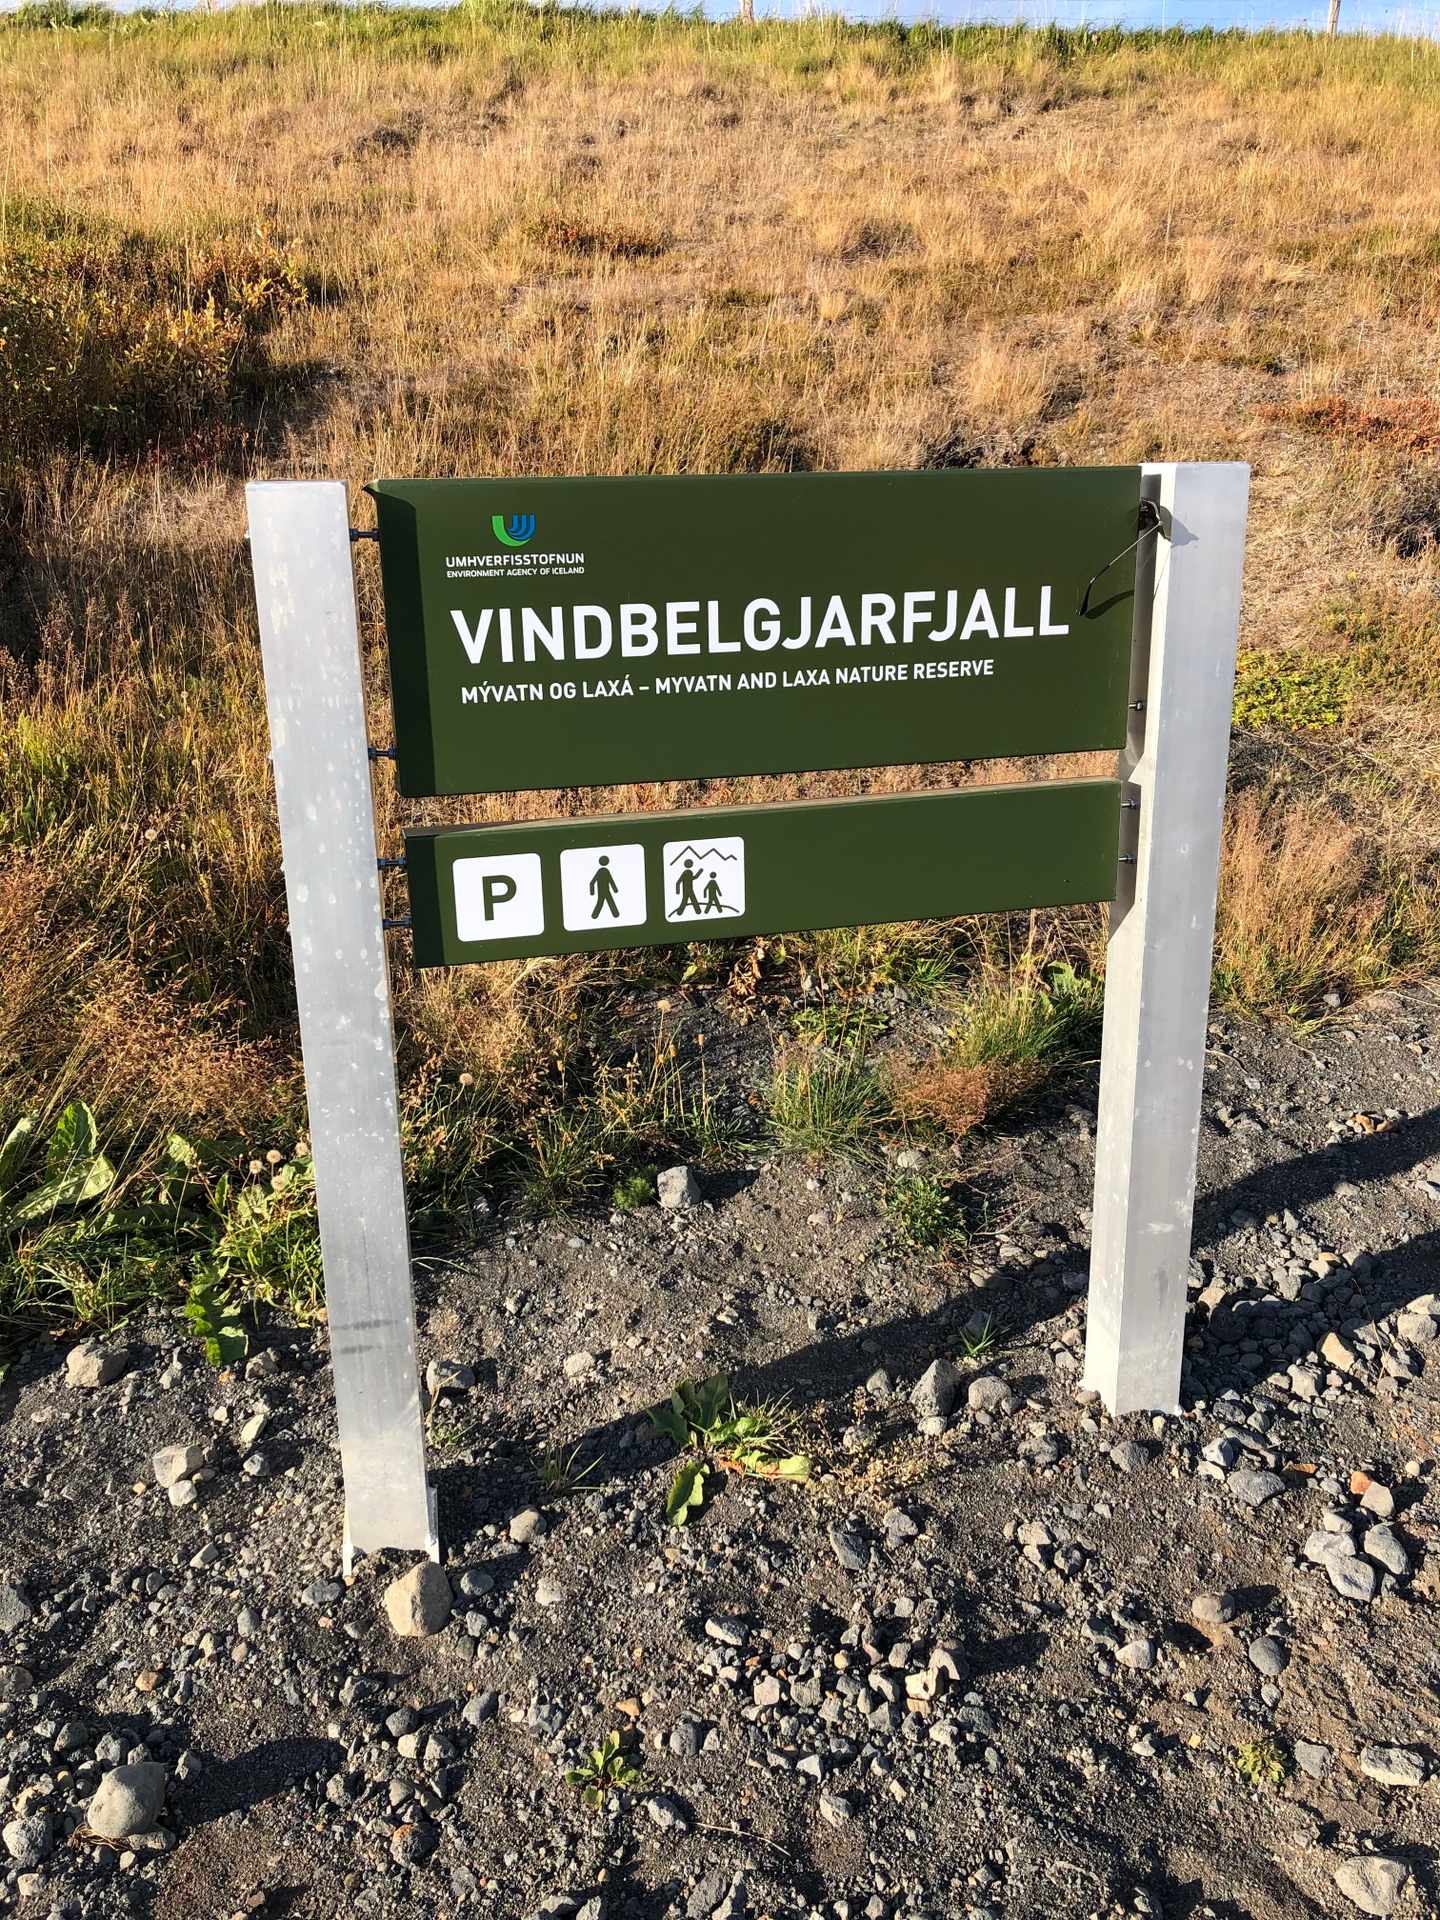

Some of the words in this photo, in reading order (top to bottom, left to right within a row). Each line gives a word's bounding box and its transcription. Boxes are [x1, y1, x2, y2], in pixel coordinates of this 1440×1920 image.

[445, 552, 585, 568] UMHVERFISSTOFNUN
[446, 568, 505, 579] ENVIRONMENT
[506, 567, 538, 577] AGENCY
[539, 567, 551, 576] OF
[551, 566, 585, 576] ICELAND
[449, 585, 1070, 665] VINDBELGJARFJALL
[461, 680, 544, 705] MÝVATN
[549, 681, 577, 700] OG
[582, 673, 634, 698] LAXÁ
[655, 673, 732, 695] MYVATN
[736, 671, 777, 691] AND
[782, 668, 831, 688] LAXA
[835, 663, 909, 685] NATURE
[913, 658, 995, 680] RESERVE
[481, 874, 517, 921] P
